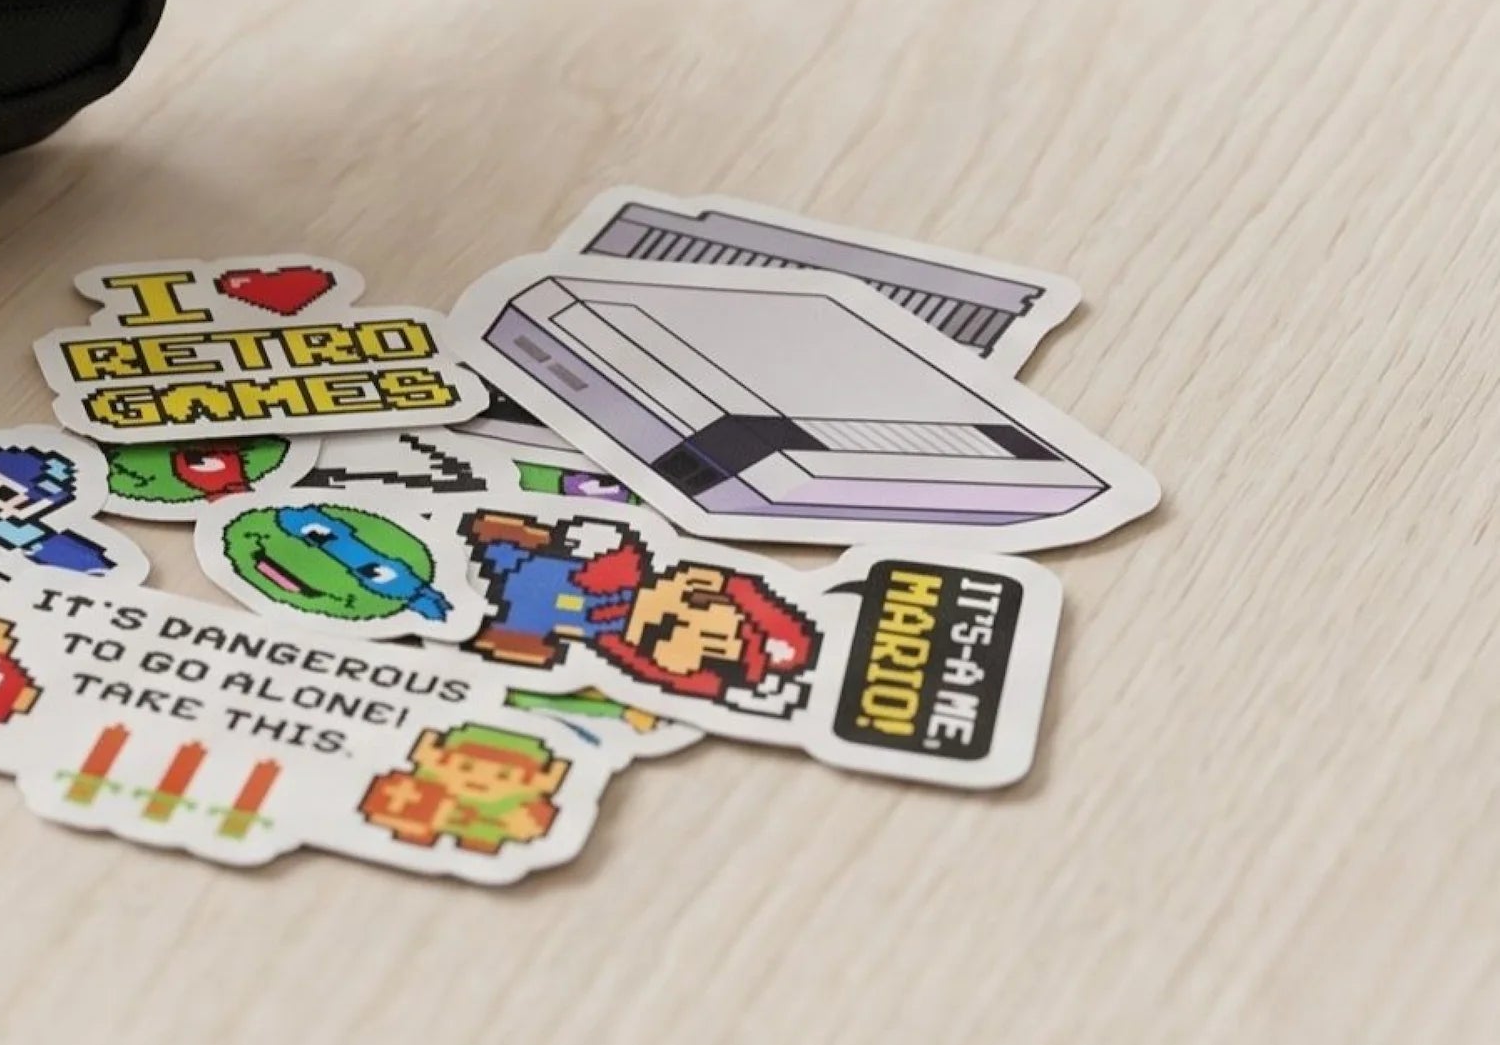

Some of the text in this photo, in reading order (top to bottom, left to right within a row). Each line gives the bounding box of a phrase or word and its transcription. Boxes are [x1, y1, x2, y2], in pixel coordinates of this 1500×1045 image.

[101, 271, 213, 326] I
[61, 319, 439, 381] RETRO
[82, 368, 461, 428] GAMES
[32, 589, 471, 704] IT'S DANGEROUS
[63, 633, 411, 729] TO GO ALONE!
[855, 570, 943, 736] MARIO!
[71, 673, 355, 758] TAKE THIS.
